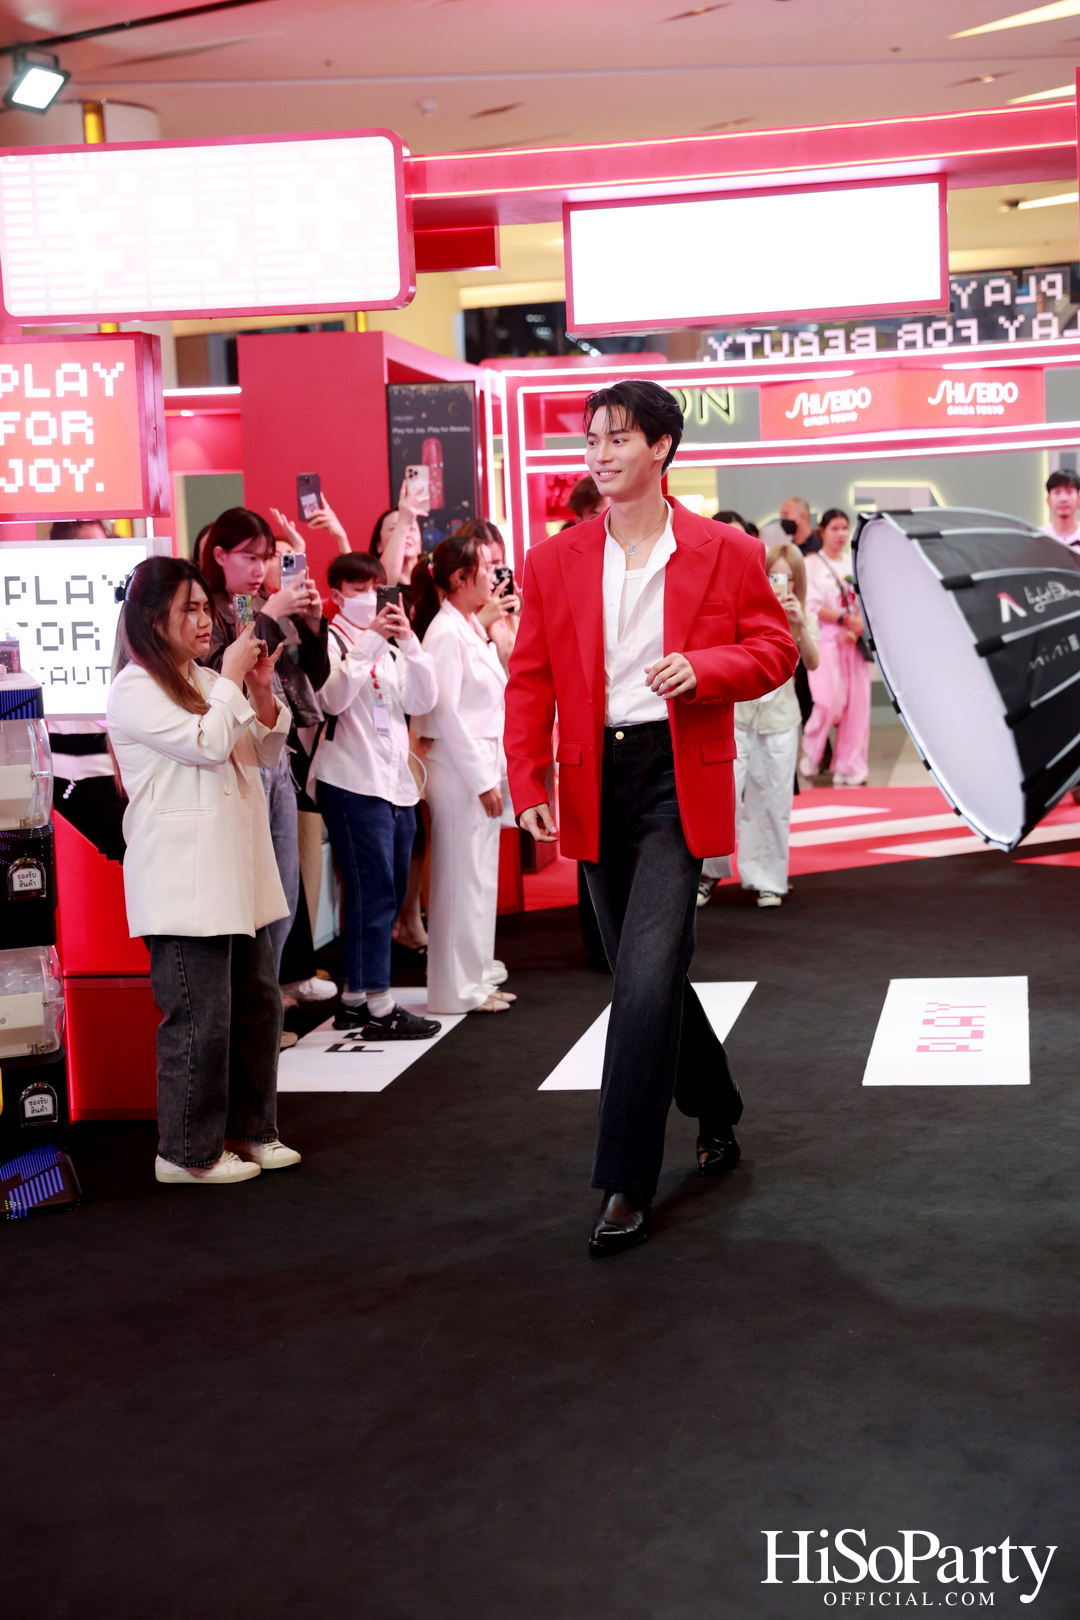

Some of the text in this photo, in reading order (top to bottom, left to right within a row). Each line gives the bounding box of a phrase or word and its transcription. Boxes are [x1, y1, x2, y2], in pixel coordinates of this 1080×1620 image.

[0, 362, 125, 399] PLAY
[926, 379, 1019, 406] SHISEIDO
[785, 386, 872, 419] SHISEIDO
[0, 410, 94, 446] FOR
[0, 458, 104, 493] JOY.
